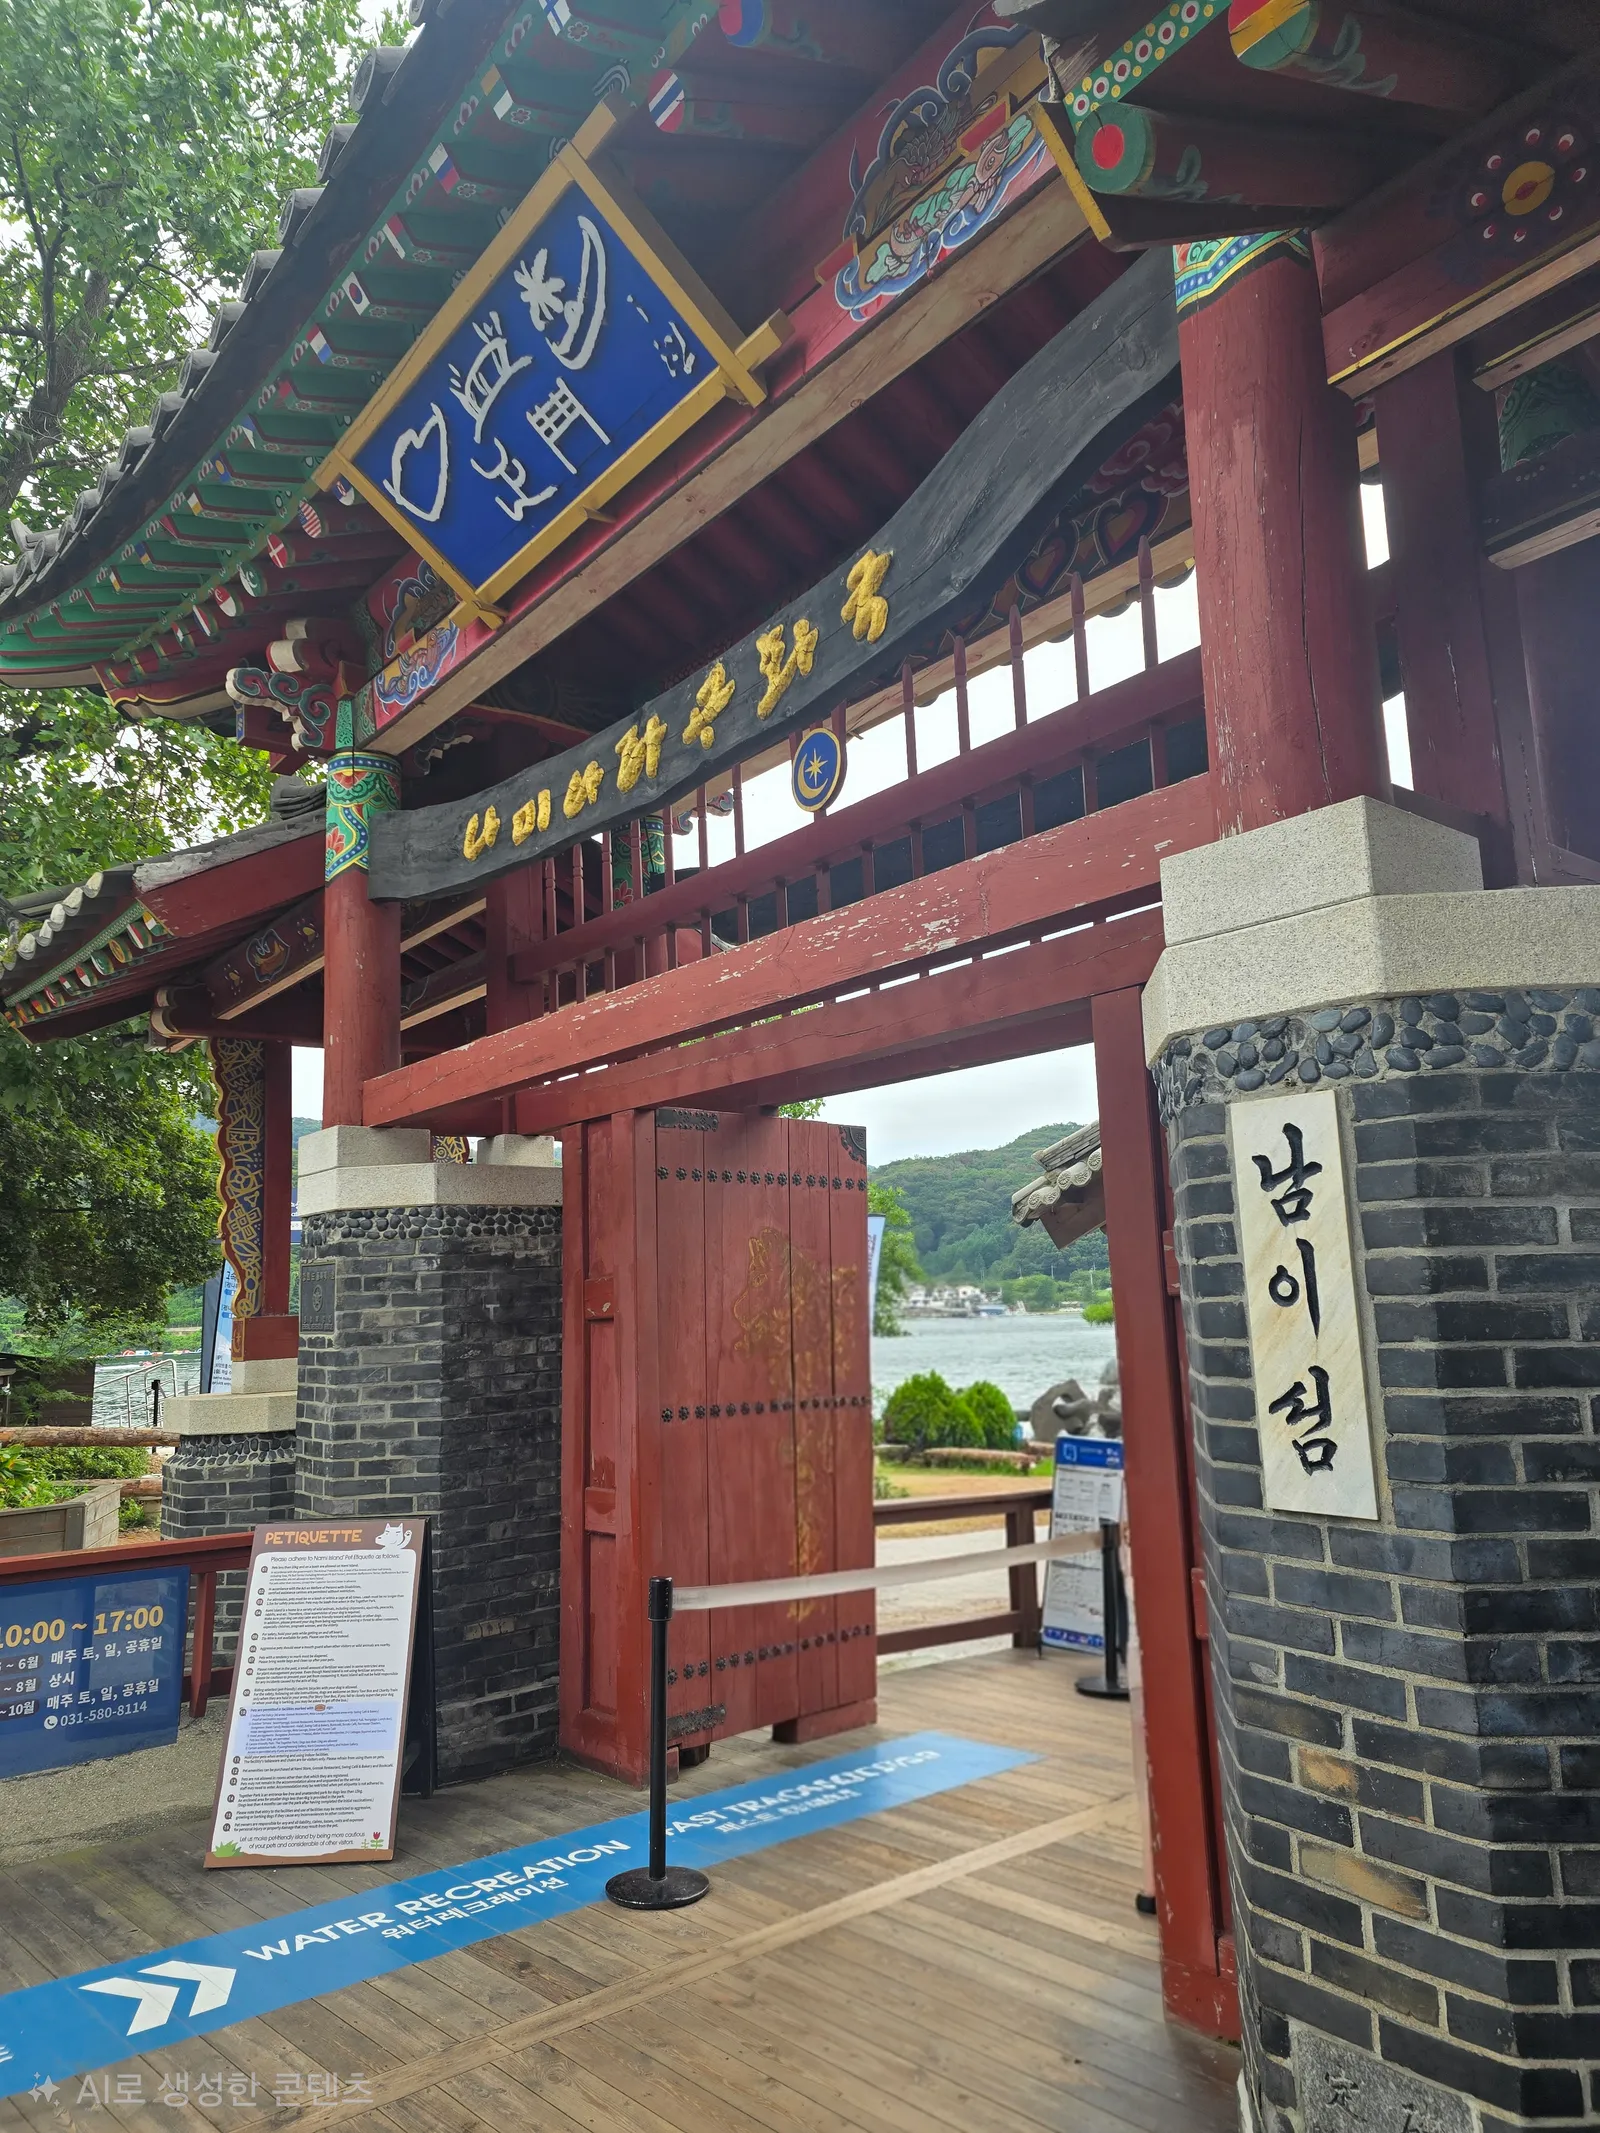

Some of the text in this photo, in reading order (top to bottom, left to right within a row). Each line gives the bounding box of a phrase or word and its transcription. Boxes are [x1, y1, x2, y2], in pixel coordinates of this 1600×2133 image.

[1251, 1122, 1338, 1476] 남이섬
[264, 1529, 362, 1545] PETIQUETTE
[94, 1605, 164, 1635] 17:00
[51, 1649, 77, 1664] 매주
[82, 1647, 99, 1660] 토,
[105, 1643, 121, 1657] 일,
[125, 1636, 163, 1654] 공휴일
[49, 1671, 75, 1687] 상시
[47, 1694, 73, 1709] 매주
[78, 1691, 96, 1705] 토,
[101, 1686, 117, 1700] 일,
[122, 1679, 159, 1697] 공휴일
[60, 1701, 148, 1726] 031-580-8114
[265, 1842, 276, 1850] pets
[267, 1834, 294, 1842] pet-friendly
[315, 1832, 331, 1840] being
[242, 1839, 632, 1962] WATER RECREATION
[381, 1875, 569, 1940] 워터레크레이션
